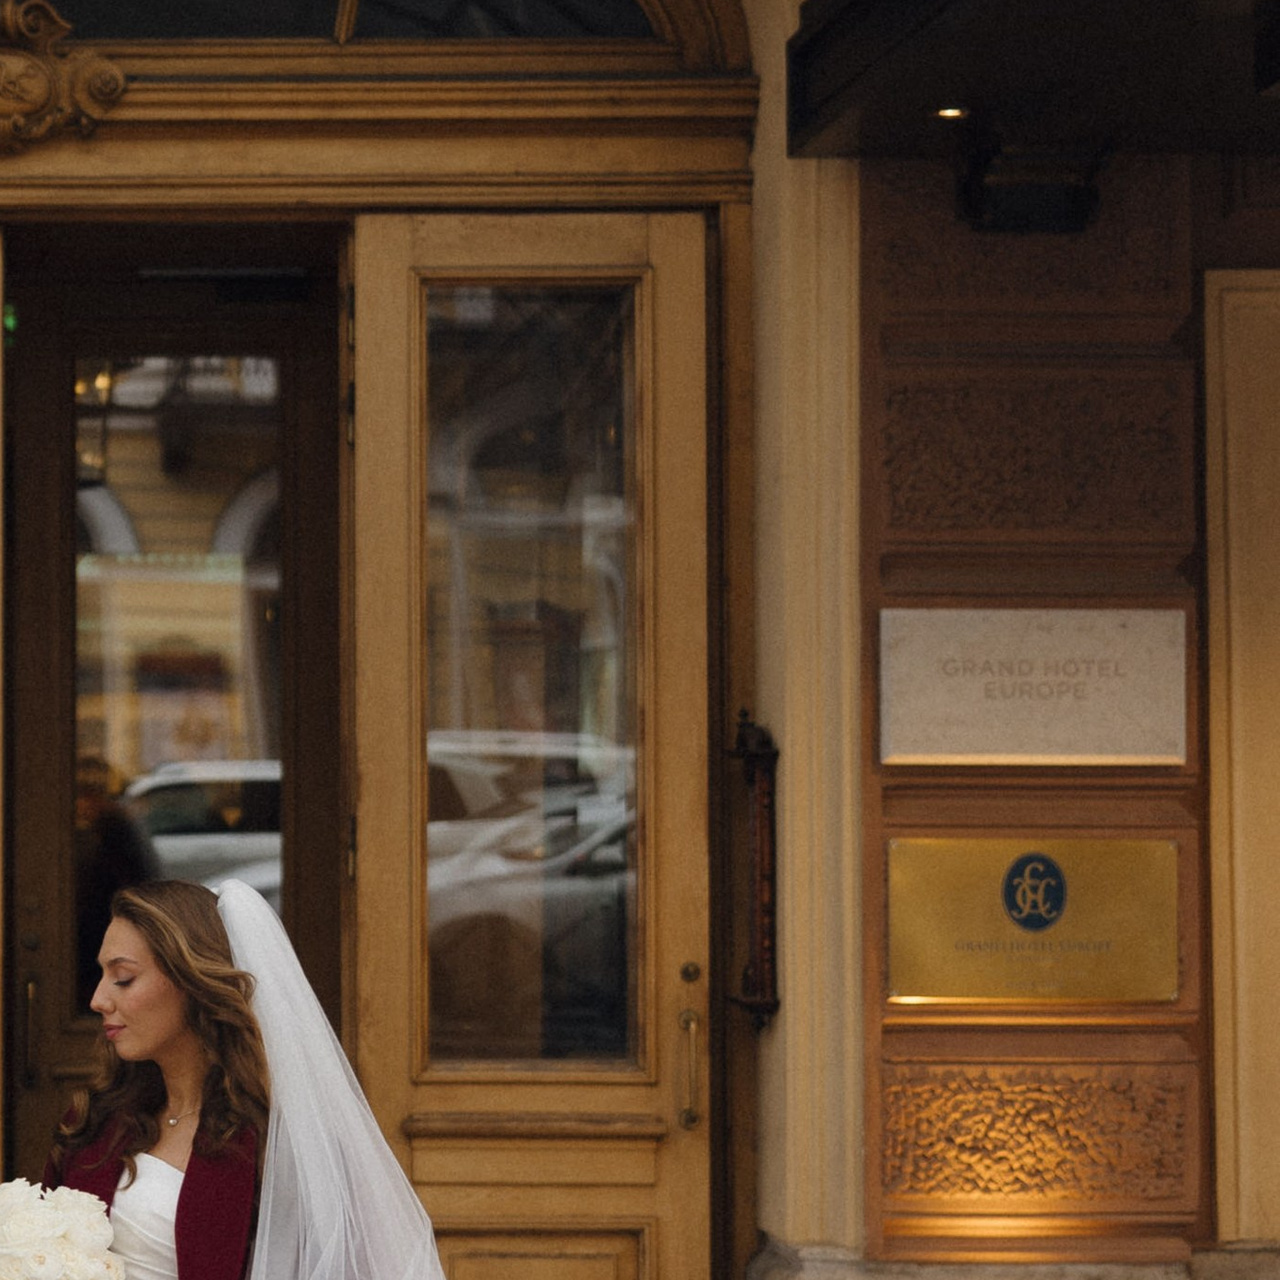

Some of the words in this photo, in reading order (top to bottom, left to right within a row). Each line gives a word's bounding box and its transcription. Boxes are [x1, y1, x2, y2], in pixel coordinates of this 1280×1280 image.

[941, 658, 1034, 677] GRAND
[1043, 658, 1127, 677] HOTEL
[984, 680, 1087, 700] EUROPE
